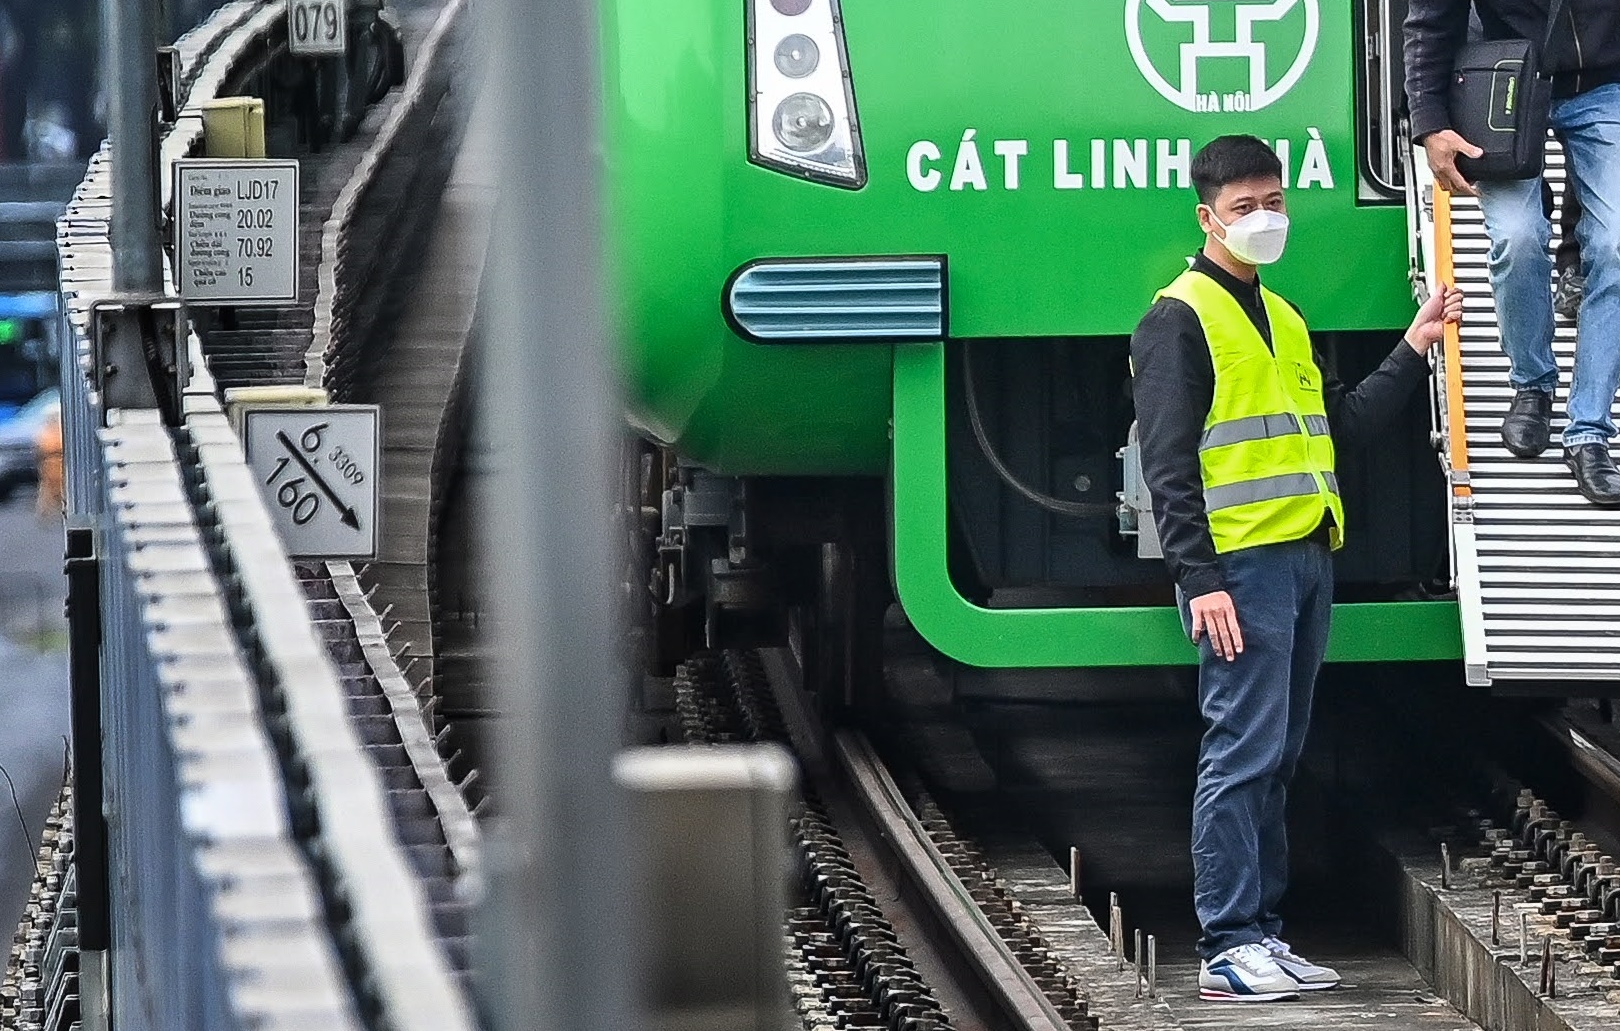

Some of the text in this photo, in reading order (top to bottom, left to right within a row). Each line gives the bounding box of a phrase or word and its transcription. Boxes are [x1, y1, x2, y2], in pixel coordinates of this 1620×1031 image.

[295, 4, 337, 41] 079
[1195, 90, 1220, 113] HÀ
[905, 128, 1028, 192] CÁT
[1053, 138, 1191, 190] LINH
[237, 180, 279, 200] LJD17
[236, 209, 273, 229] 20.02
[236, 237, 273, 258] 70.92
[238, 267, 254, 287] 15
[266, 457, 320, 526] 160
